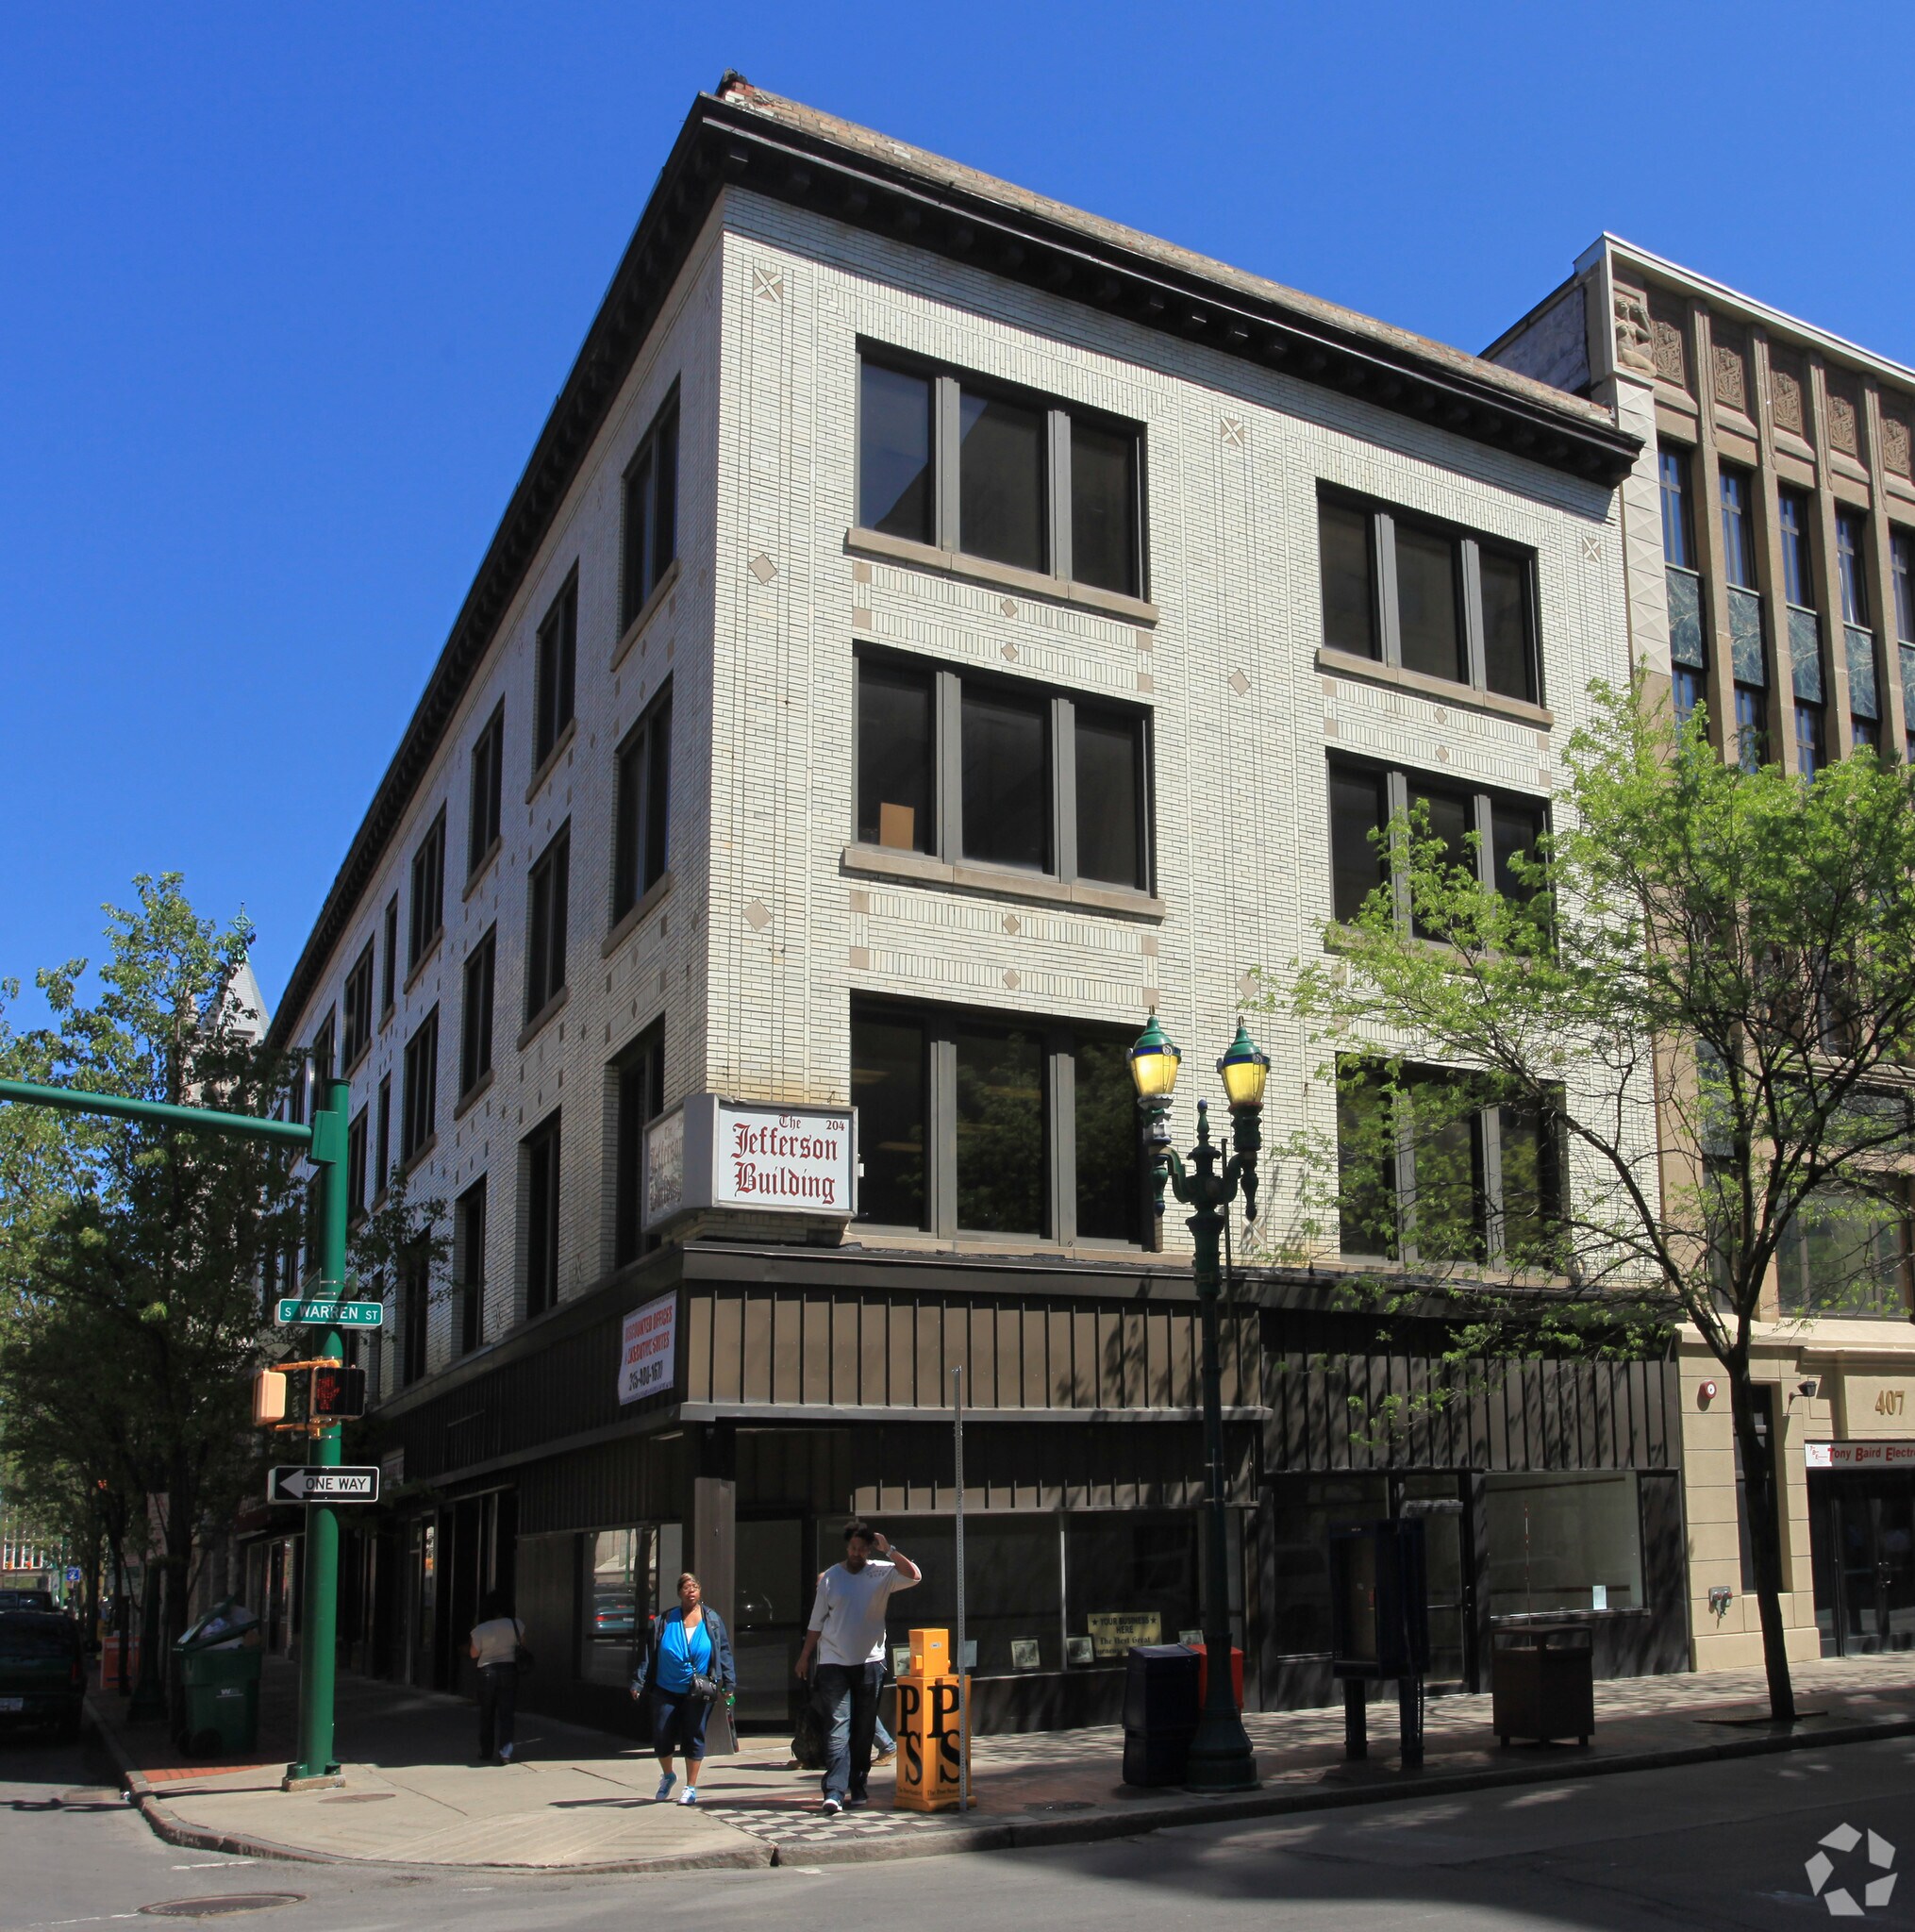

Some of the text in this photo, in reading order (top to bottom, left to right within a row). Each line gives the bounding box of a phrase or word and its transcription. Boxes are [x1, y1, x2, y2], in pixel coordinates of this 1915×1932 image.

[778, 1114, 801, 1130] The
[826, 1120, 845, 1131] 204
[730, 1123, 838, 1161] Jefferson
[733, 1160, 836, 1205] Building
[285, 1305, 378, 1321] S WARREN ST
[652, 1330, 670, 1354] SUITES
[1874, 1390, 1905, 1415] 407
[1827, 1447, 1851, 1461] Tony
[1856, 1447, 1881, 1461] Baird
[306, 1477, 367, 1490] ONE WAY
[1100, 1616, 1150, 1625] YOUR BUSINESS
[1116, 1625, 1134, 1634] HERE
[1100, 1637, 1111, 1645] The
[1132, 1636, 1151, 1644] Great
[897, 1685, 920, 1738] P
[927, 1684, 960, 1739] P
[906, 1731, 923, 1785] S
[940, 1729, 968, 1784] S
